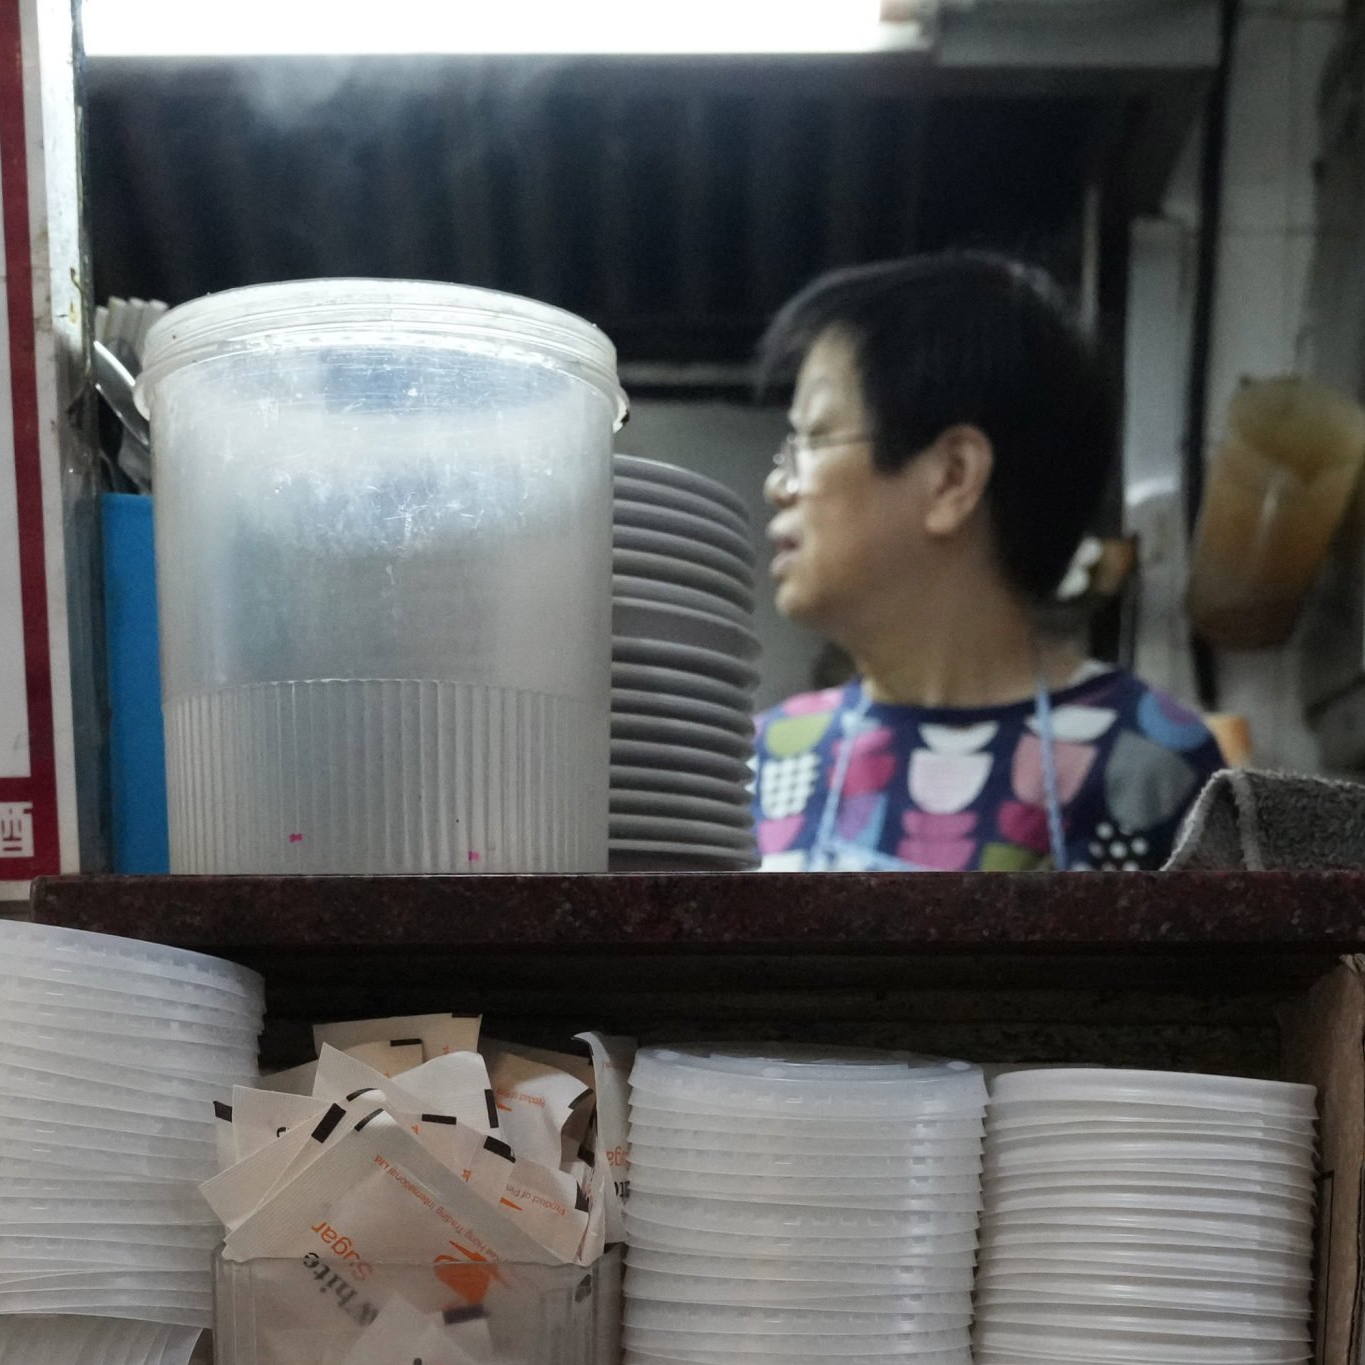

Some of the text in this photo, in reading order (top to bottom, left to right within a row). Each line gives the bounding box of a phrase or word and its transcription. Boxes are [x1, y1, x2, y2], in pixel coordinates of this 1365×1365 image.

[385, 1163, 436, 1210] International
[531, 1194, 567, 1216] Product
[434, 1204, 465, 1234] Trading
[303, 1249, 379, 1327] White
